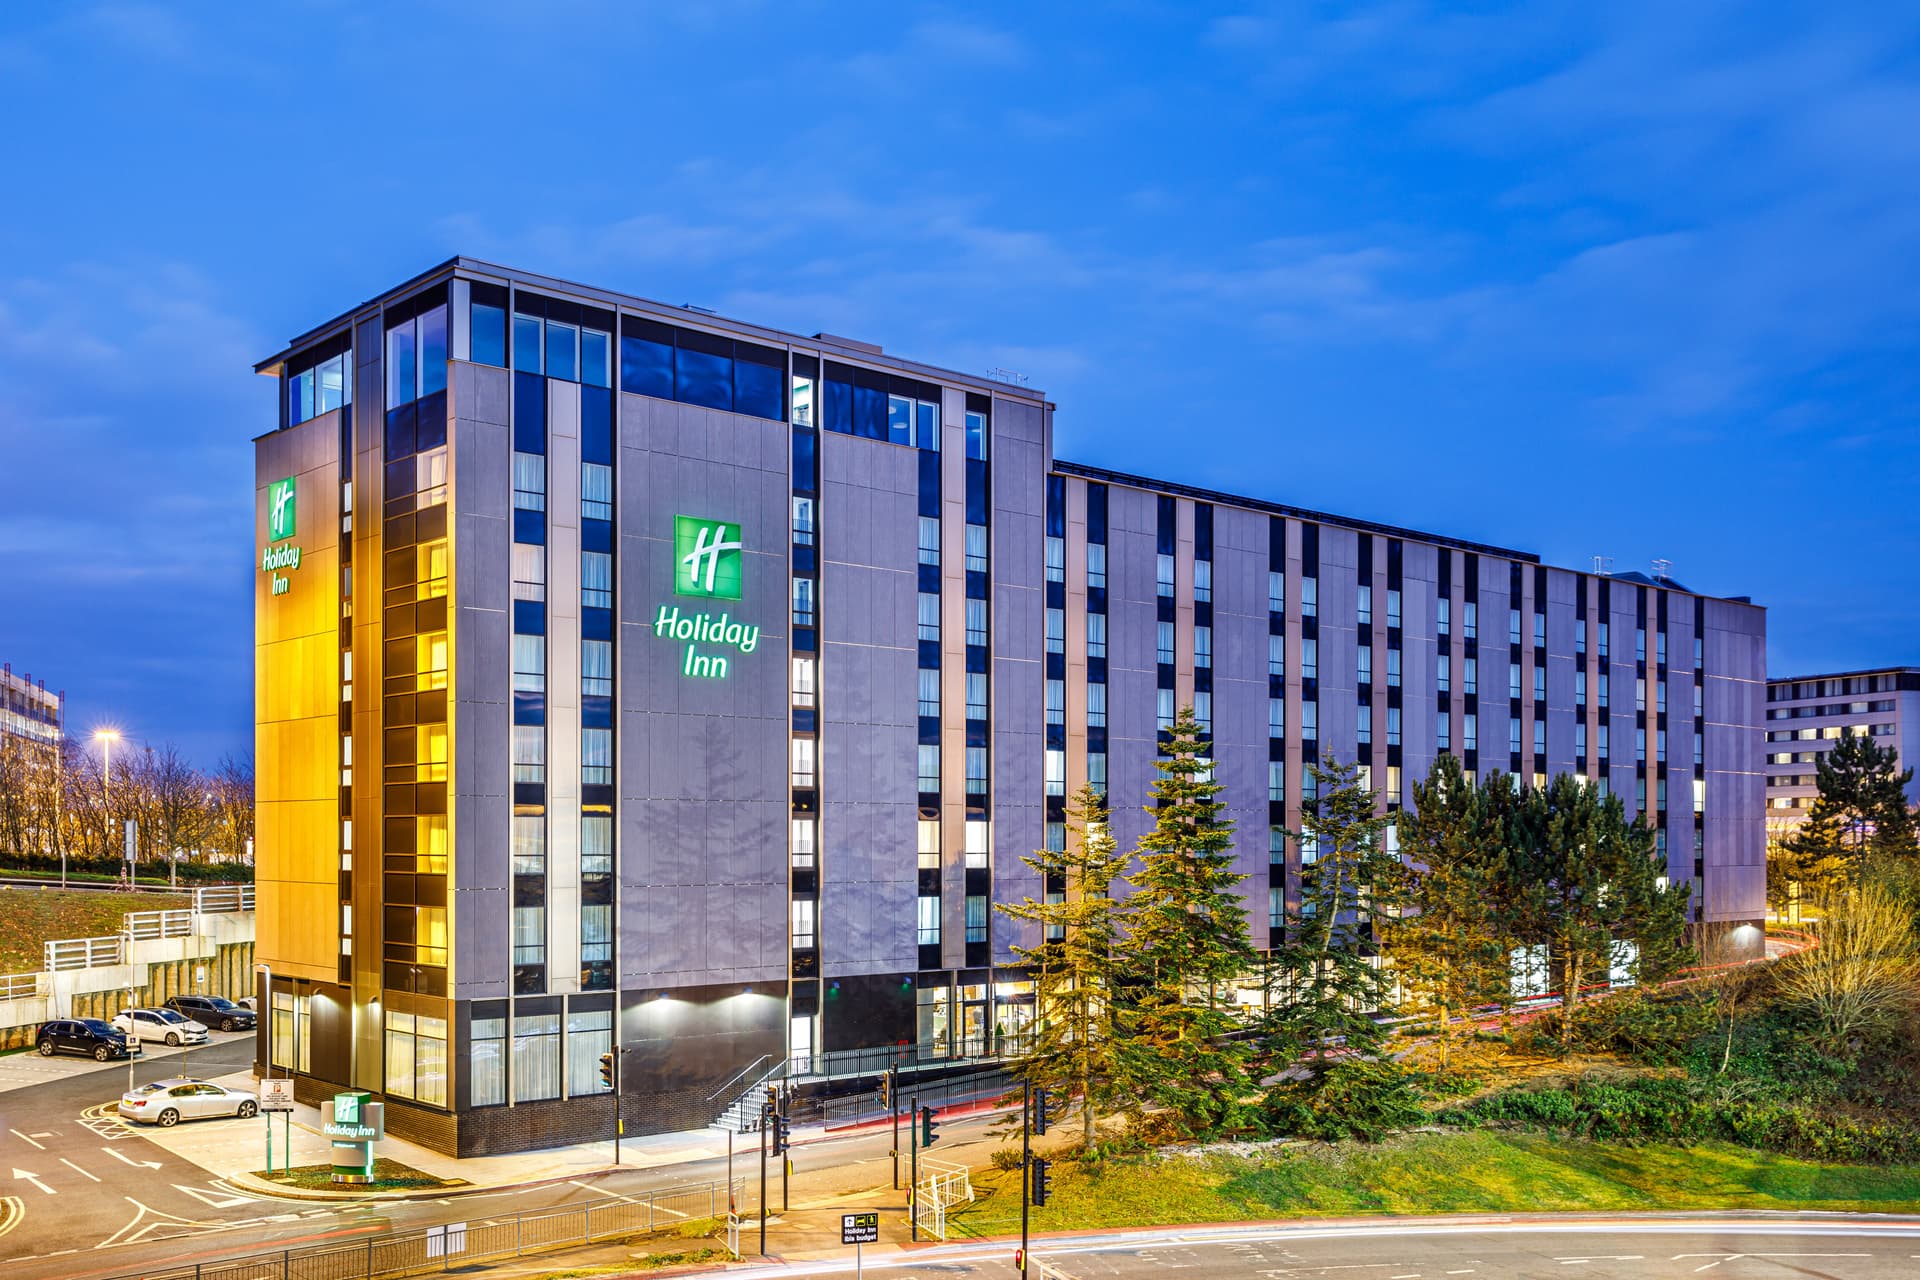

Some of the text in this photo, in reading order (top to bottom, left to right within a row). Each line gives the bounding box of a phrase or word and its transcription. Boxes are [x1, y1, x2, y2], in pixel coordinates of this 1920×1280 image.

[263, 543, 300, 571] Holiday
[272, 572, 288, 595] Inn
[655, 606, 759, 652] Holiday
[684, 645, 727, 678] Inn
[324, 1123, 376, 1138] Holiday Inn
[856, 1233, 877, 1241] budget
